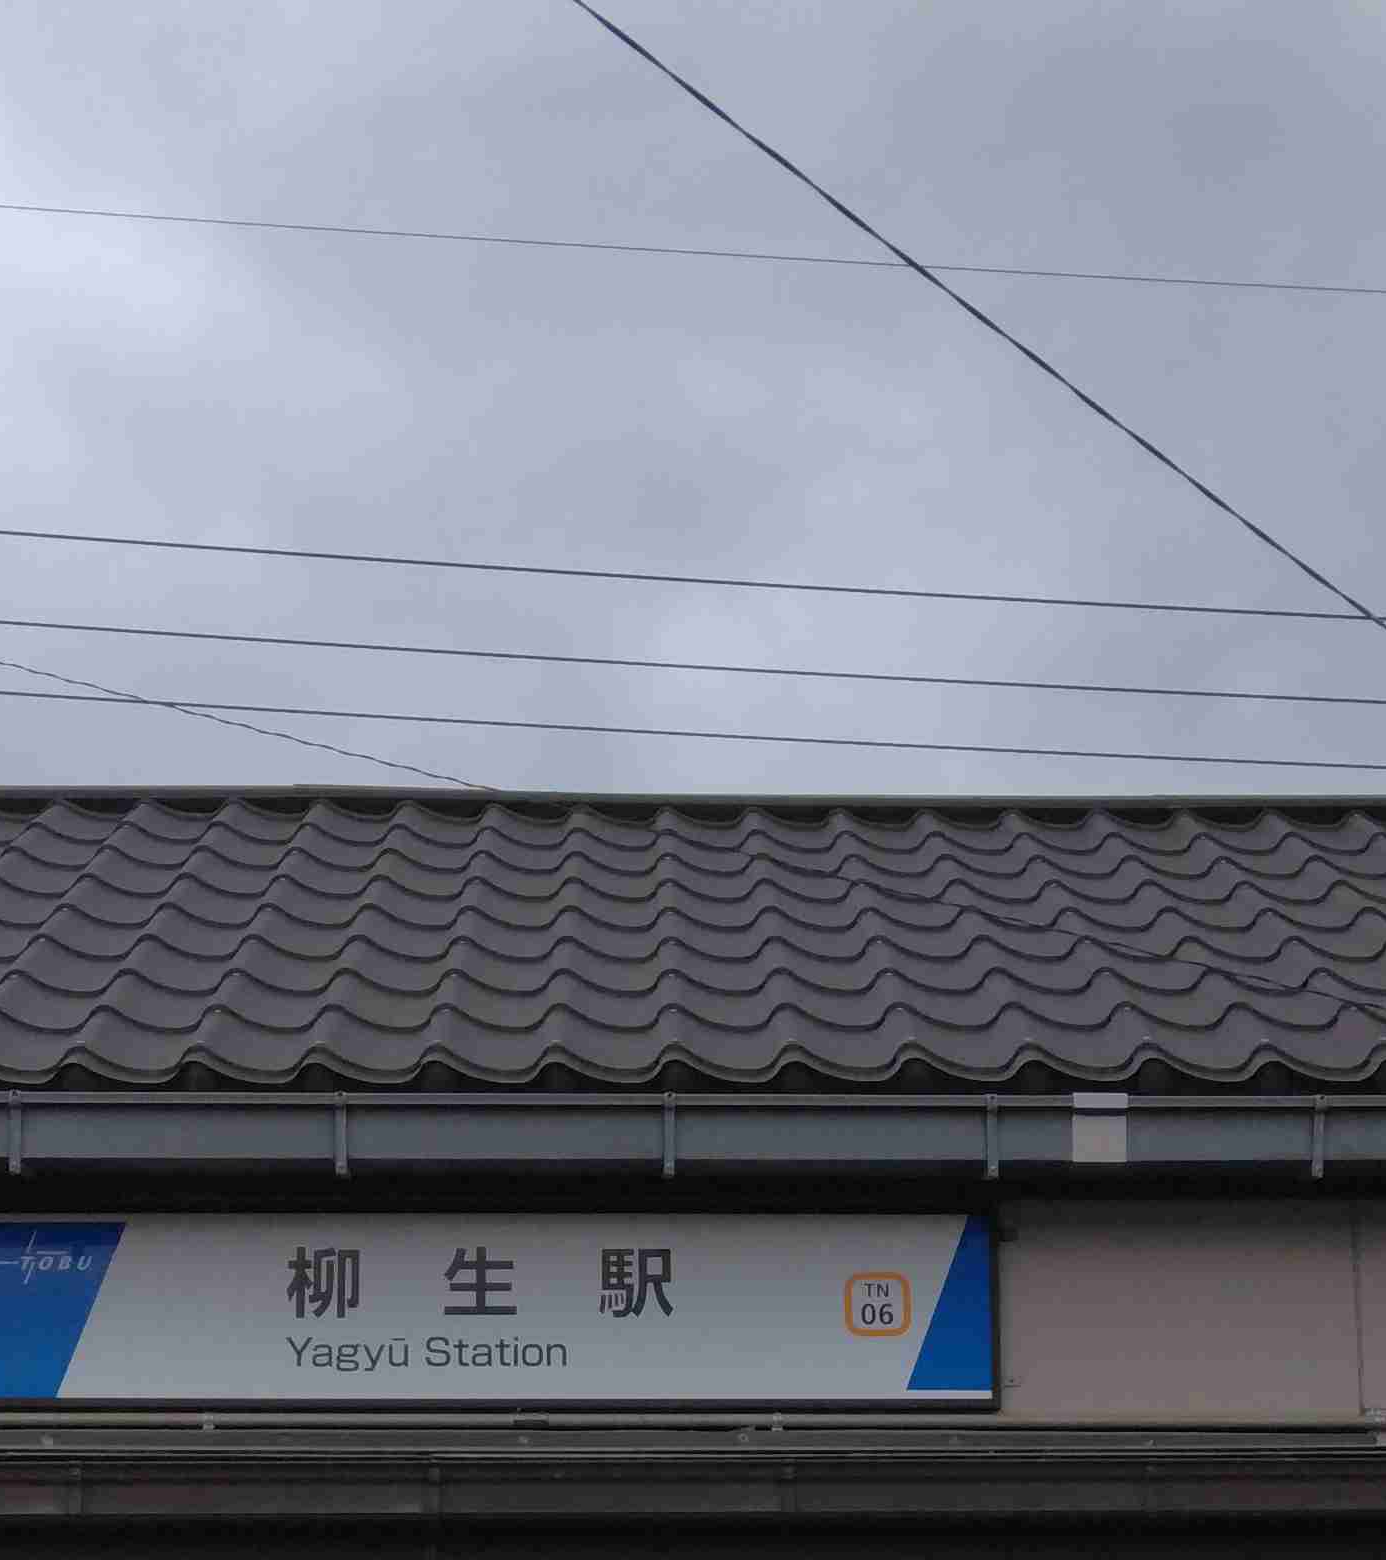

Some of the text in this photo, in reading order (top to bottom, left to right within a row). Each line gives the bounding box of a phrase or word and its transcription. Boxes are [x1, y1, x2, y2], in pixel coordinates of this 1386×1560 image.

[286, 1245, 674, 1319] 柳生駅
[863, 1283, 890, 1298] TN
[860, 1303, 894, 1325] 06
[285, 1335, 568, 1372] Yagyū Station
